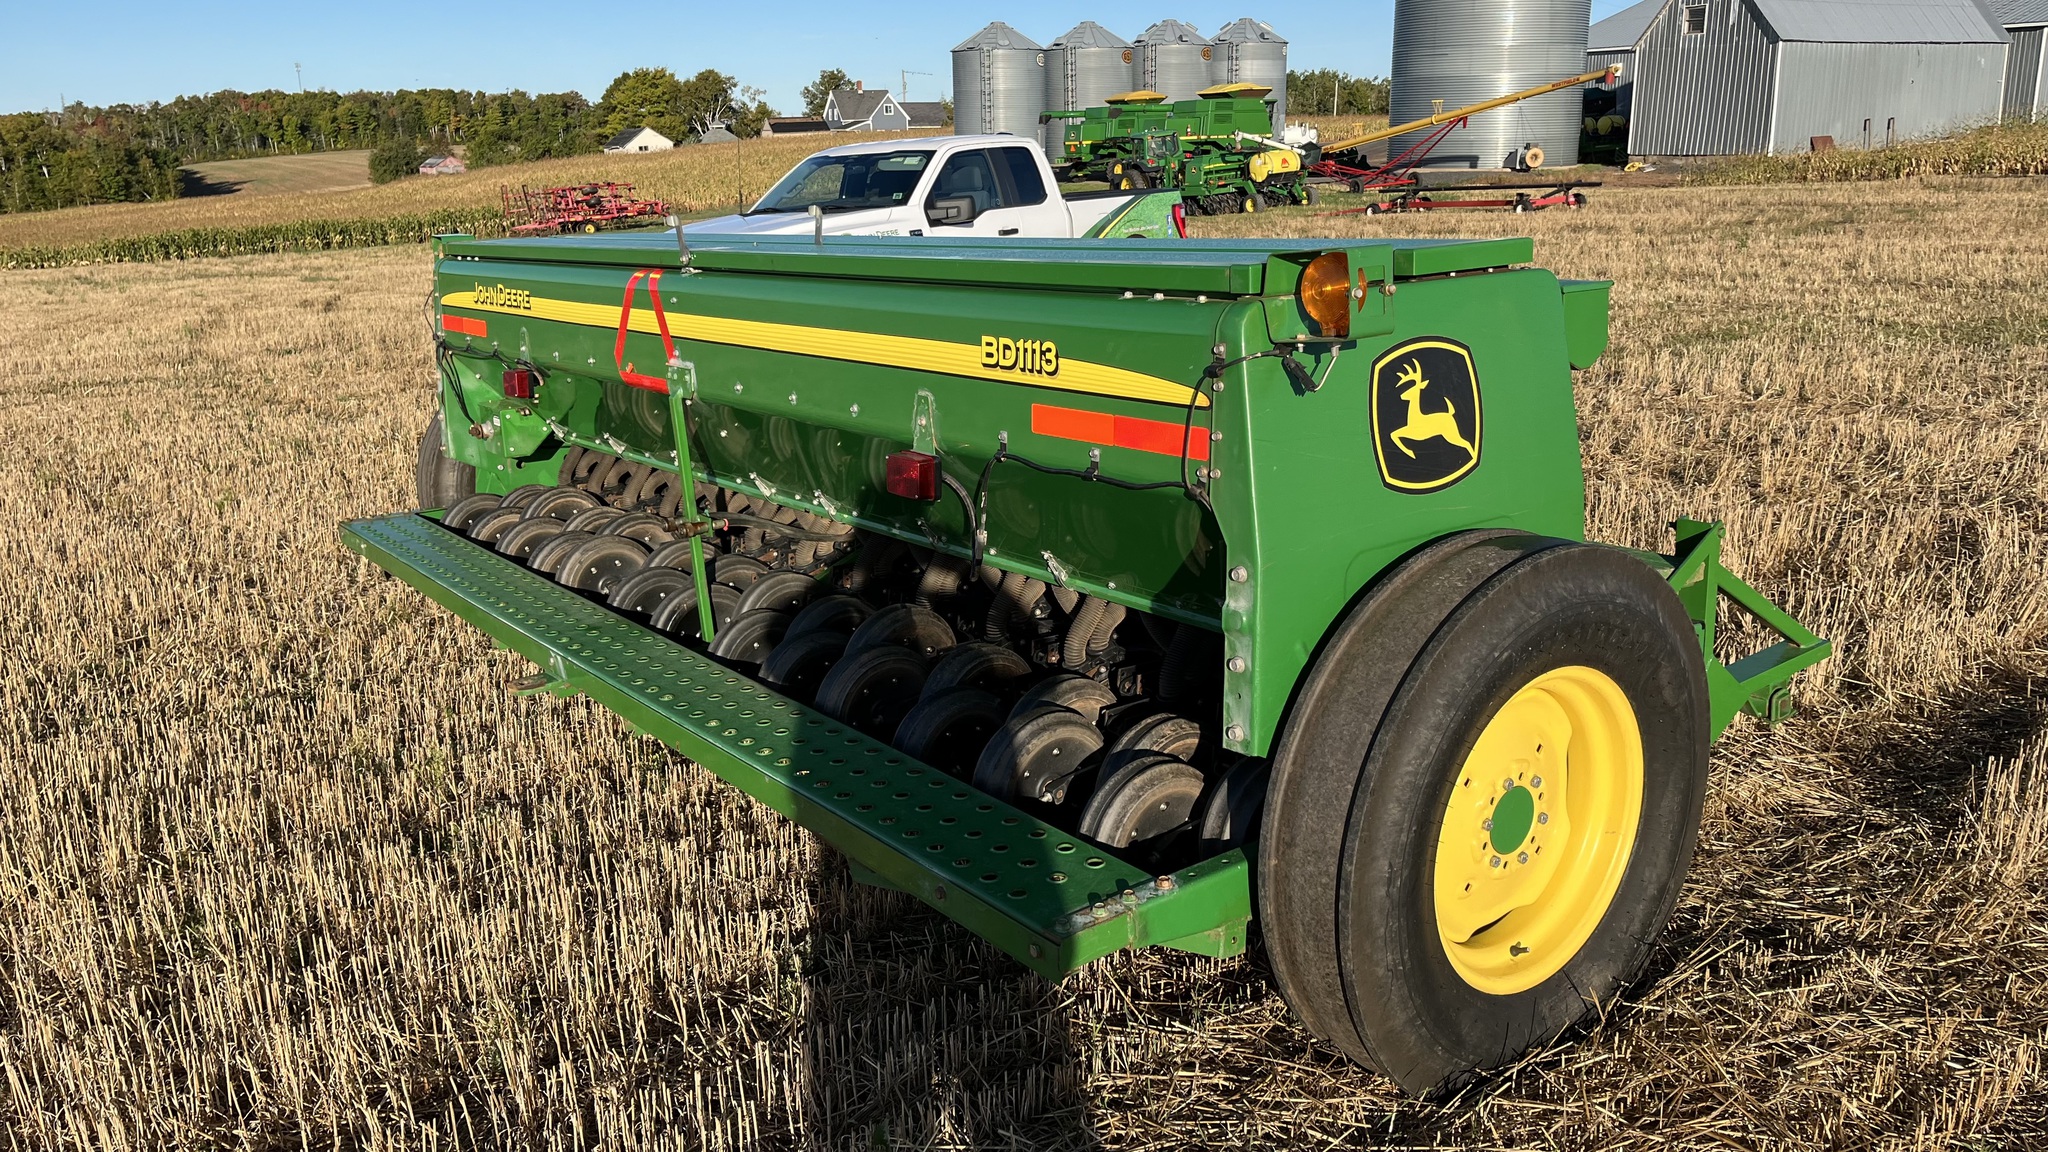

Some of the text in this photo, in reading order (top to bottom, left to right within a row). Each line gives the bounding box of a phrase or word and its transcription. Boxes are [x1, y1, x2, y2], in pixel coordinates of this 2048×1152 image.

[876, 229, 900, 237] DEERE
[473, 282, 532, 310] JOHN DEERE
[981, 335, 1059, 377] BD1113
